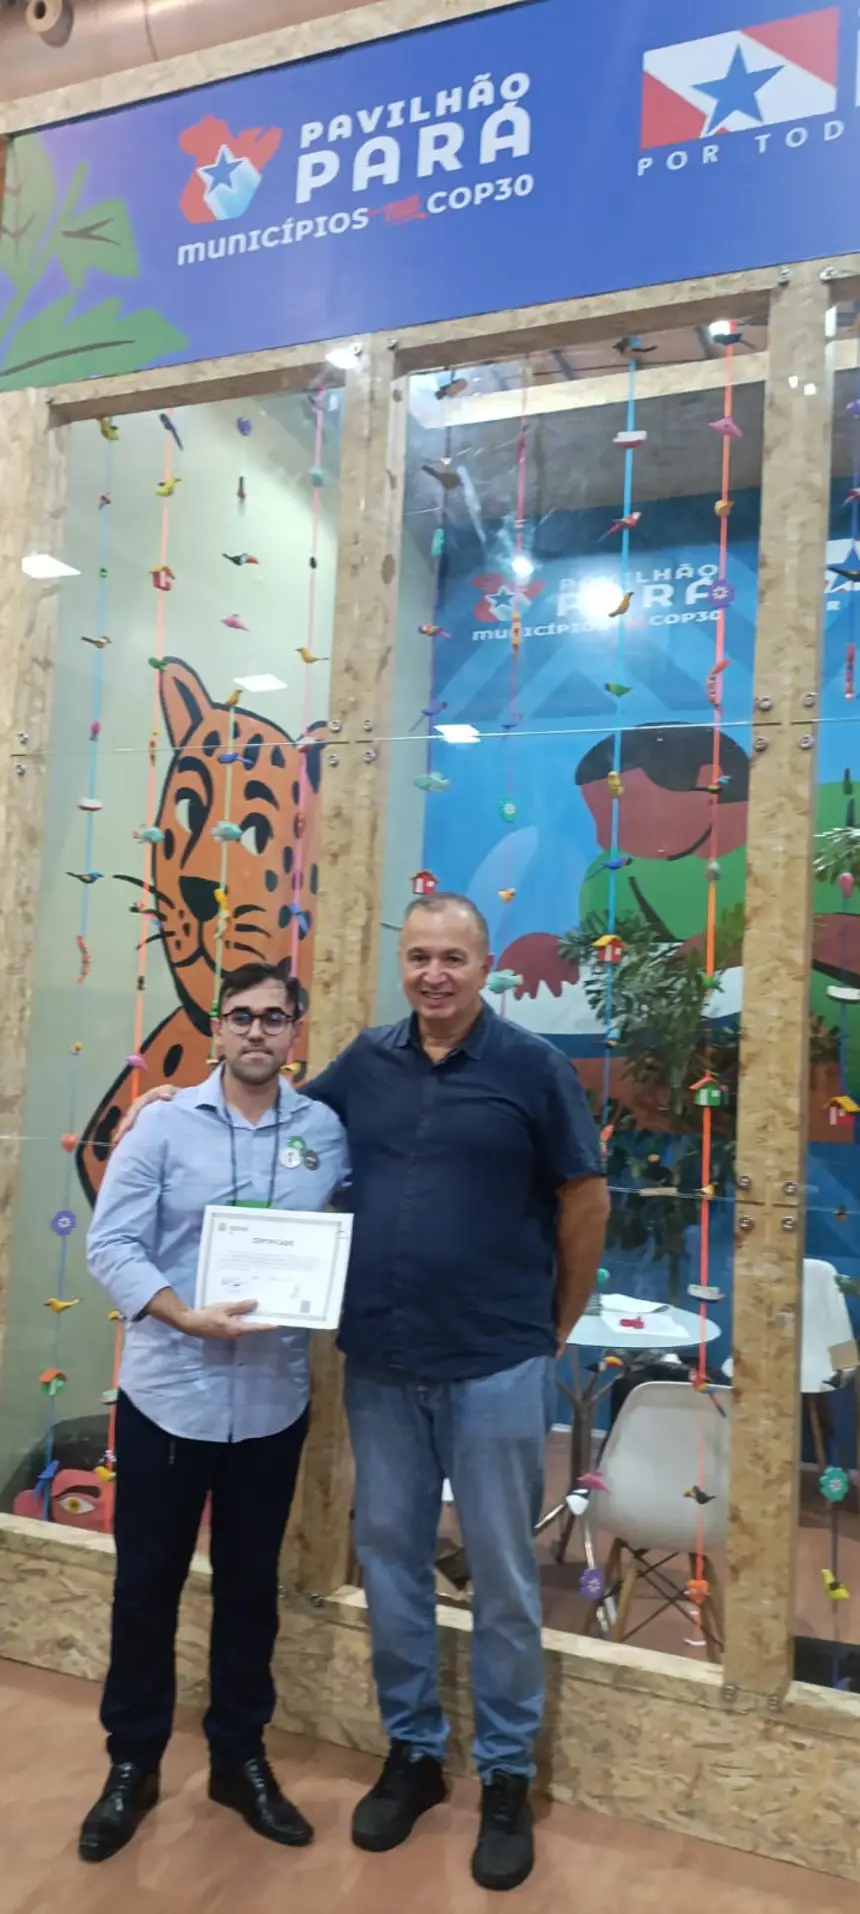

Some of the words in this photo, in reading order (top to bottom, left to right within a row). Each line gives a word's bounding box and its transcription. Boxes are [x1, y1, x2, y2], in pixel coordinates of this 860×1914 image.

[295, 101, 532, 204] PARÁ
[300, 72, 531, 149] PAVILHÃO
[637, 144, 720, 177] POR
[754, 120, 845, 154] TOD
[177, 207, 369, 266] MUNICÍPIOS
[426, 173, 534, 215] COP30
